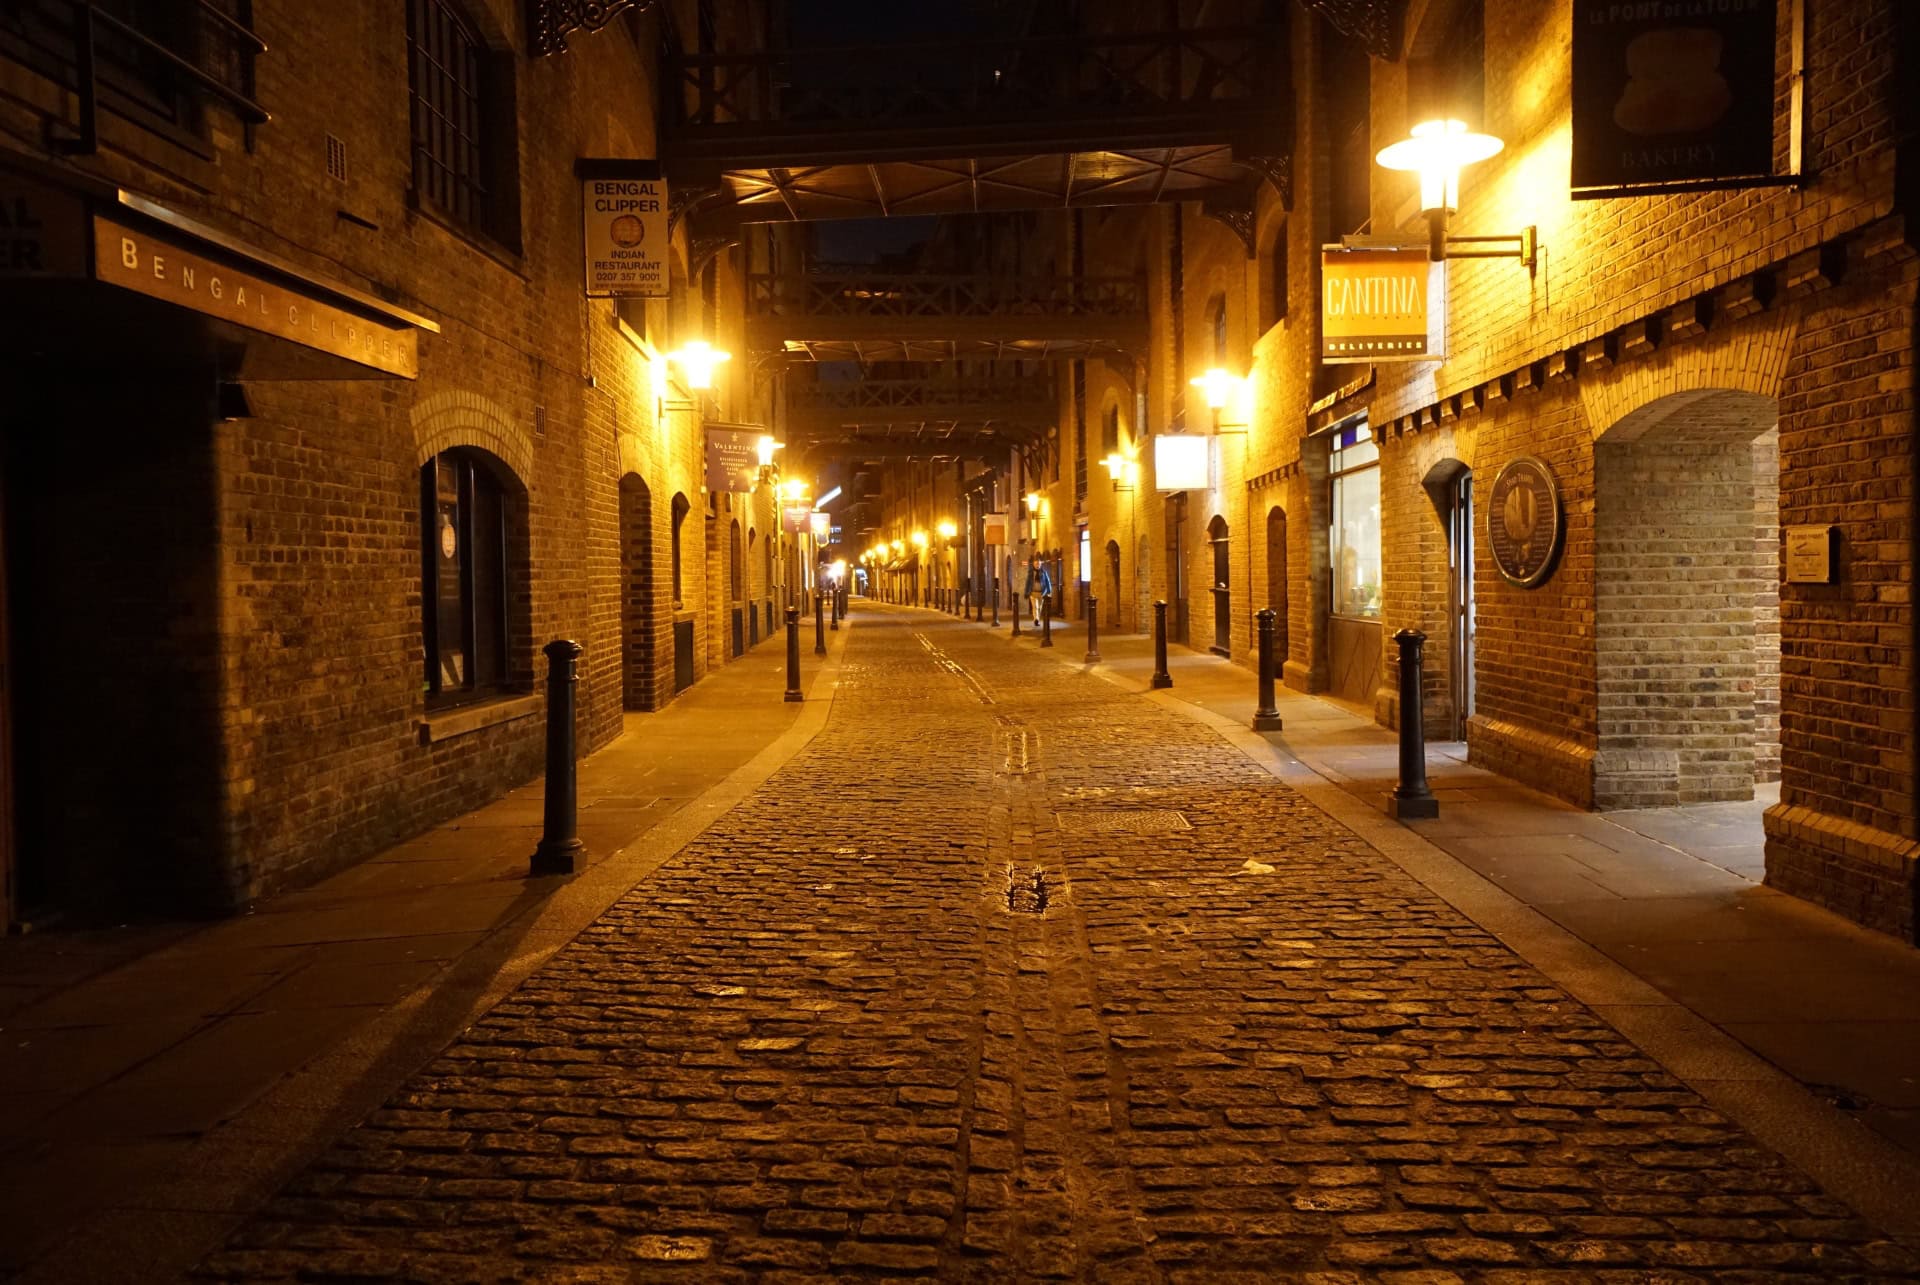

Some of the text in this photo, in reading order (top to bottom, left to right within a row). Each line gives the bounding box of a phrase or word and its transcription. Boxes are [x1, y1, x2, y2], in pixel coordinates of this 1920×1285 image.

[1609, 1, 1660, 23] PONT
[1622, 144, 1717, 169] BAKERY
[594, 182, 659, 196] BENGAL
[594, 199, 660, 213] CLIPPER
[611, 250, 645, 259] INDIAN
[594, 261, 661, 271] RESTAURANT
[595, 272, 661, 282] 0207 357 9001
[121, 237, 269, 315] BENGAL
[288, 304, 410, 368] CLIPPER
[1327, 276, 1423, 316] CANTINA
[1328, 342, 1423, 351] DELIVERIES
